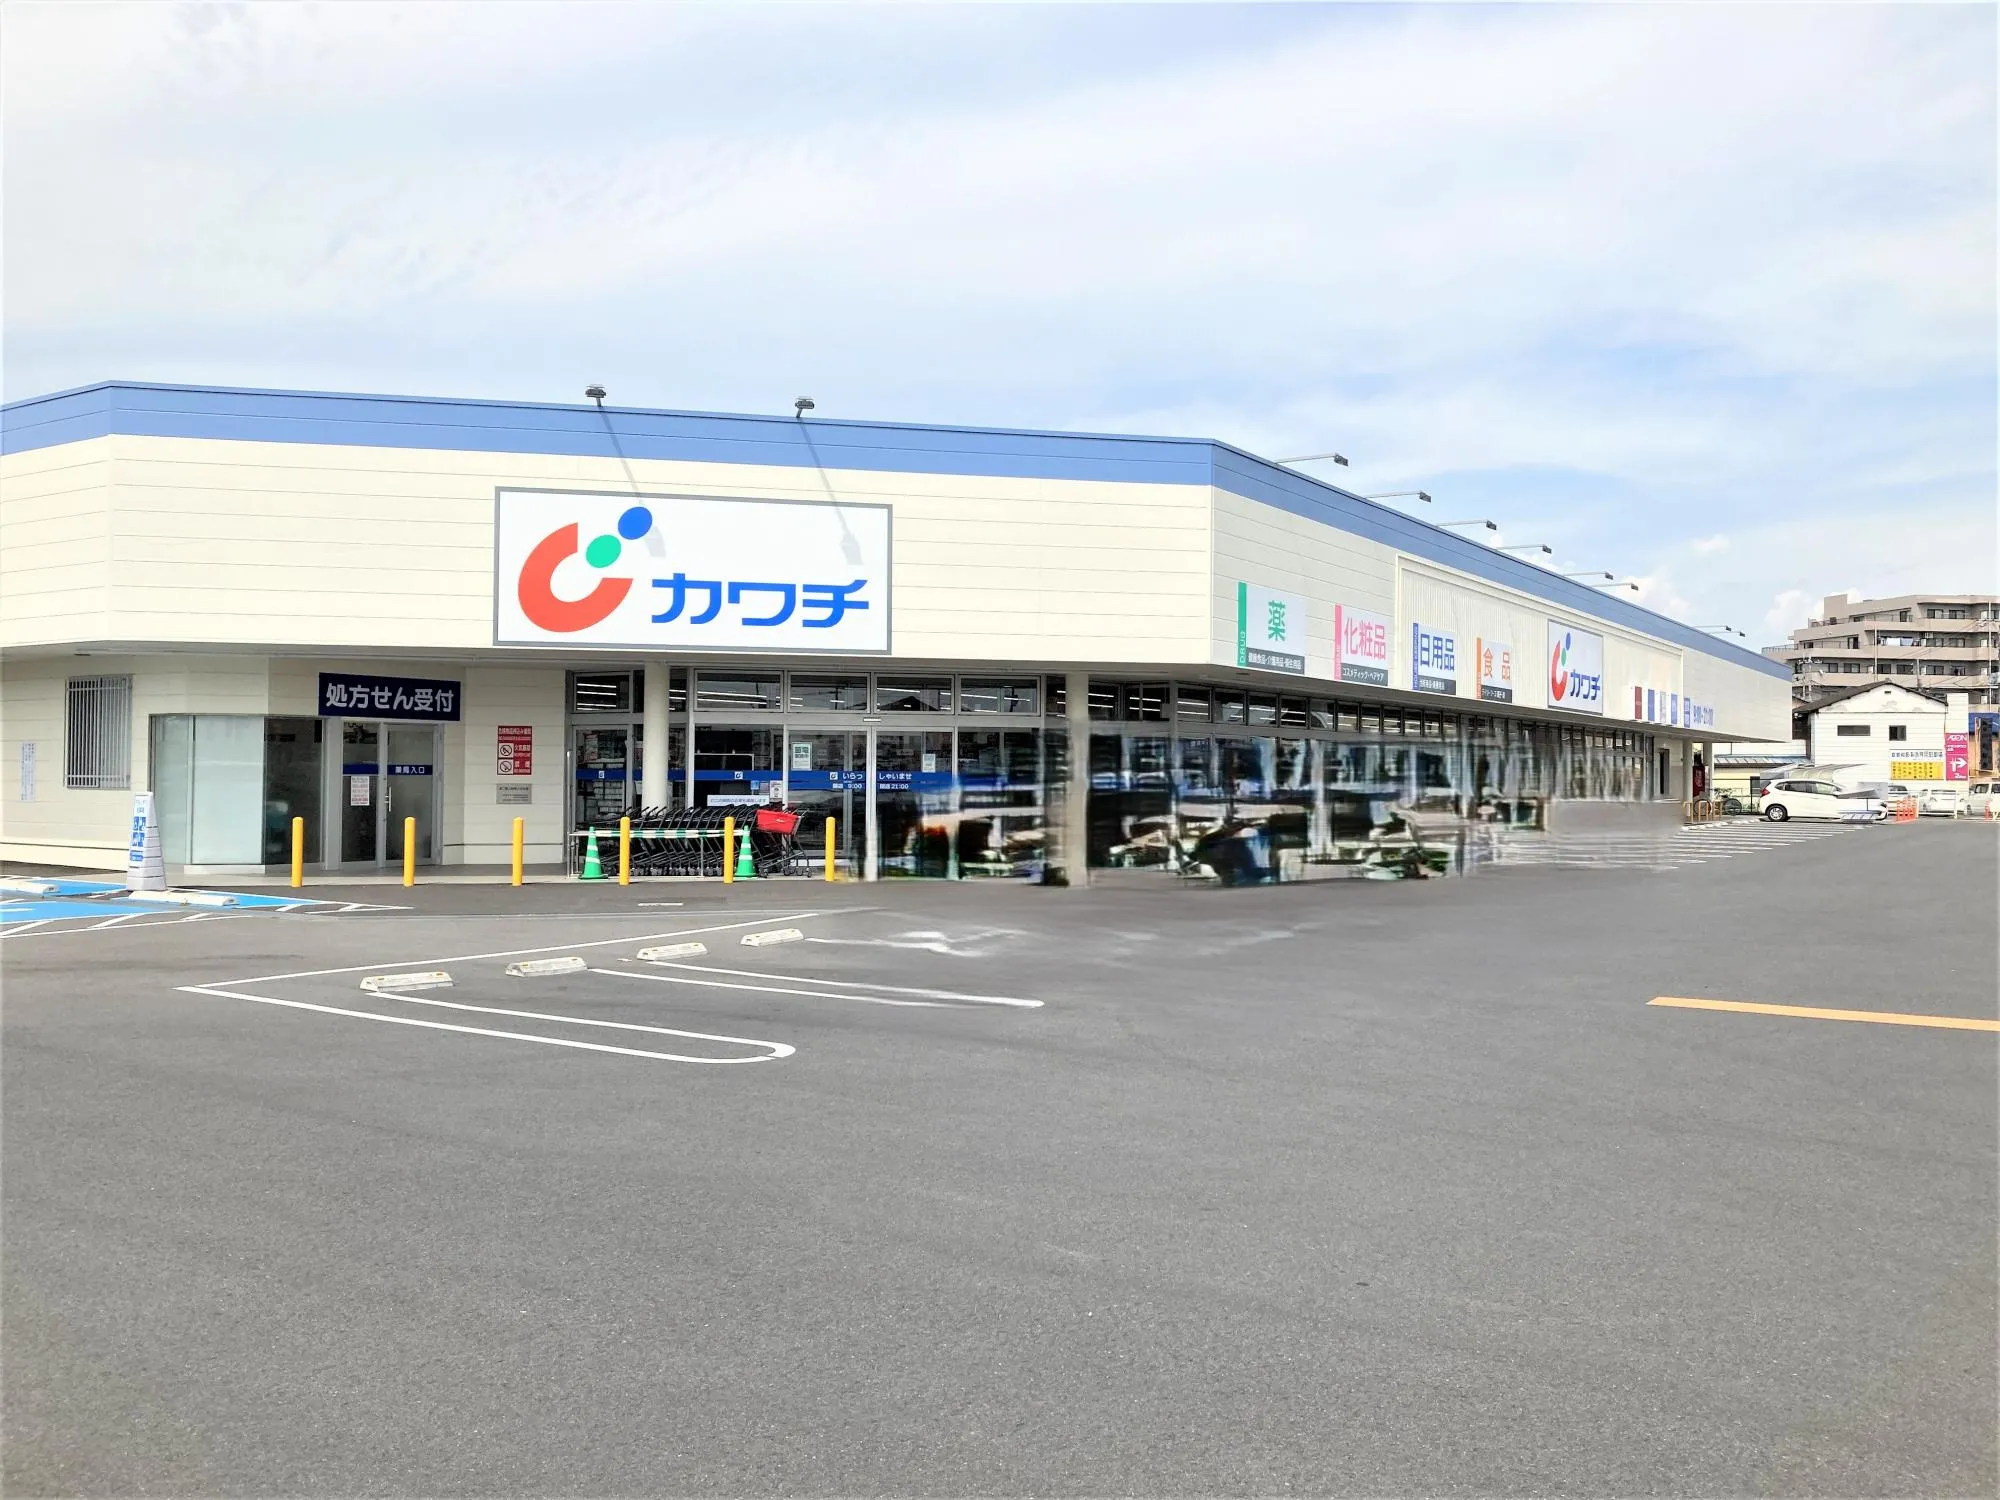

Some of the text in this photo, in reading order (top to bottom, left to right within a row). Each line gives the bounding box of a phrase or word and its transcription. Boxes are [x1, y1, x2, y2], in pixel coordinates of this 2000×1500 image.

[652, 572, 870, 629] カワチ
[1267, 600, 1286, 642] 薬
[1344, 616, 1386, 661] 化粧品
[1420, 633, 1455, 672] 日用品
[326, 683, 454, 713] 処方せん受付
[1570, 669, 1600, 701] カワチ
